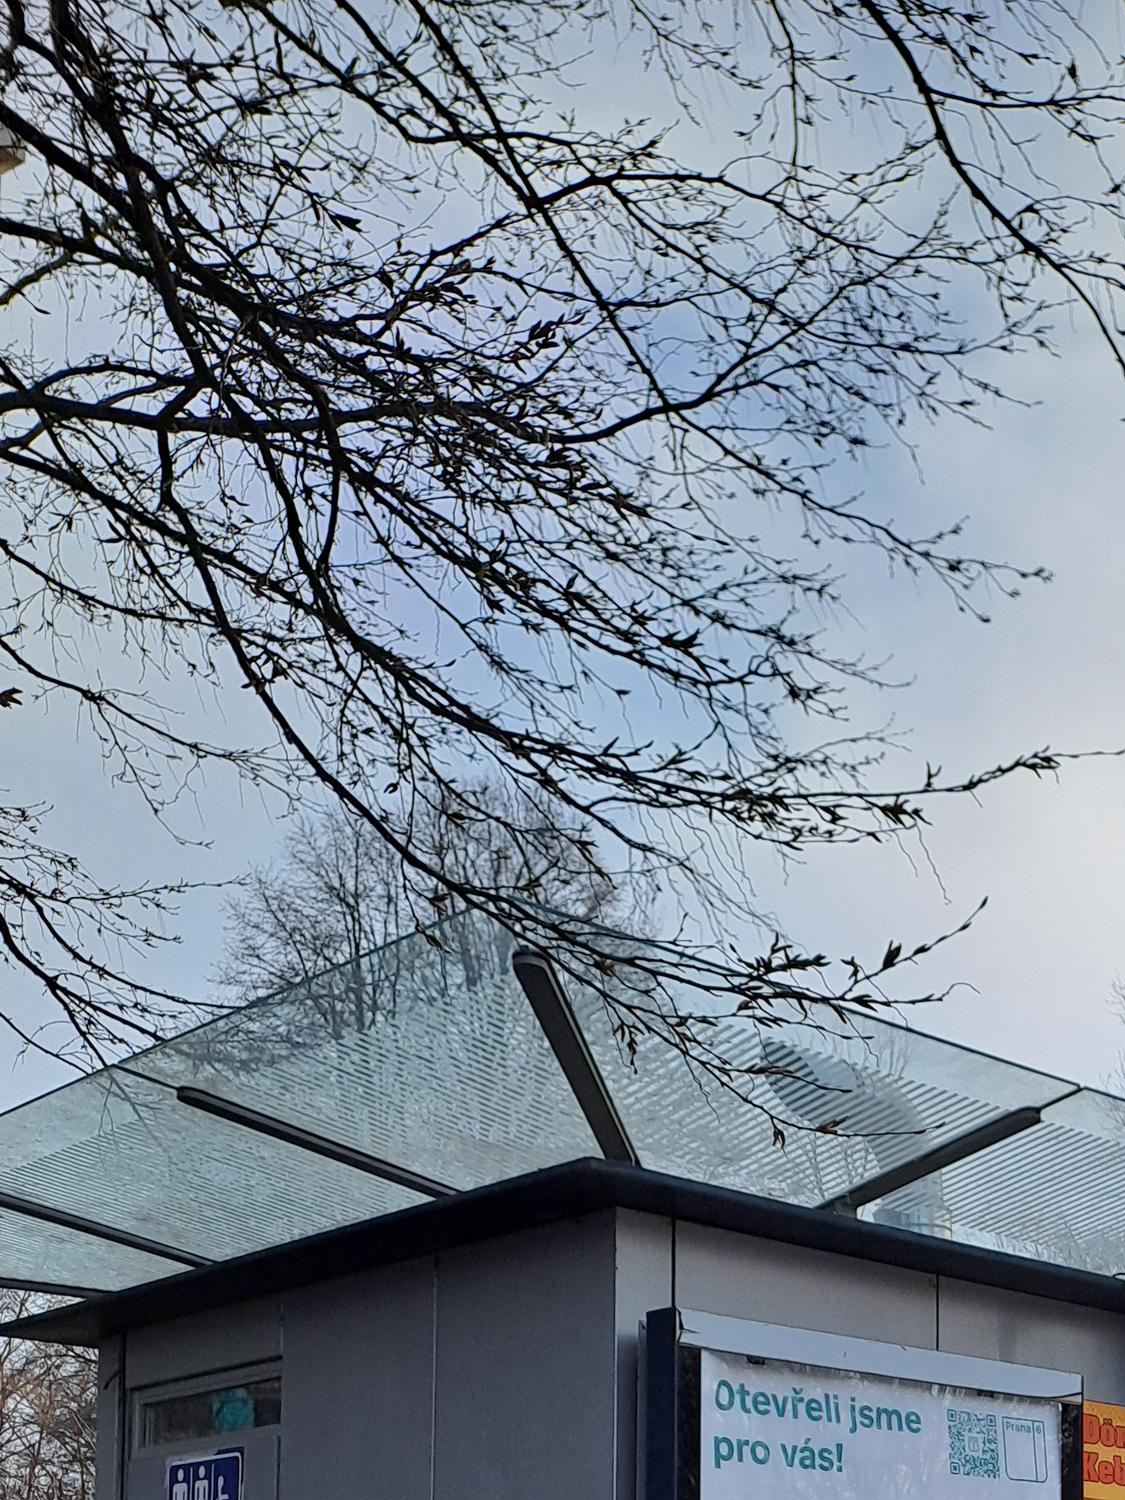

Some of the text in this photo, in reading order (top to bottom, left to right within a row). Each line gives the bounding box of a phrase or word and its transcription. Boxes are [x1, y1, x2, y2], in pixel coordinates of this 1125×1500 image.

[714, 1379, 922, 1434] Otevřeli jsme
[1005, 1421, 1042, 1434] Praha 6
[713, 1434, 844, 1472] pro vás!
